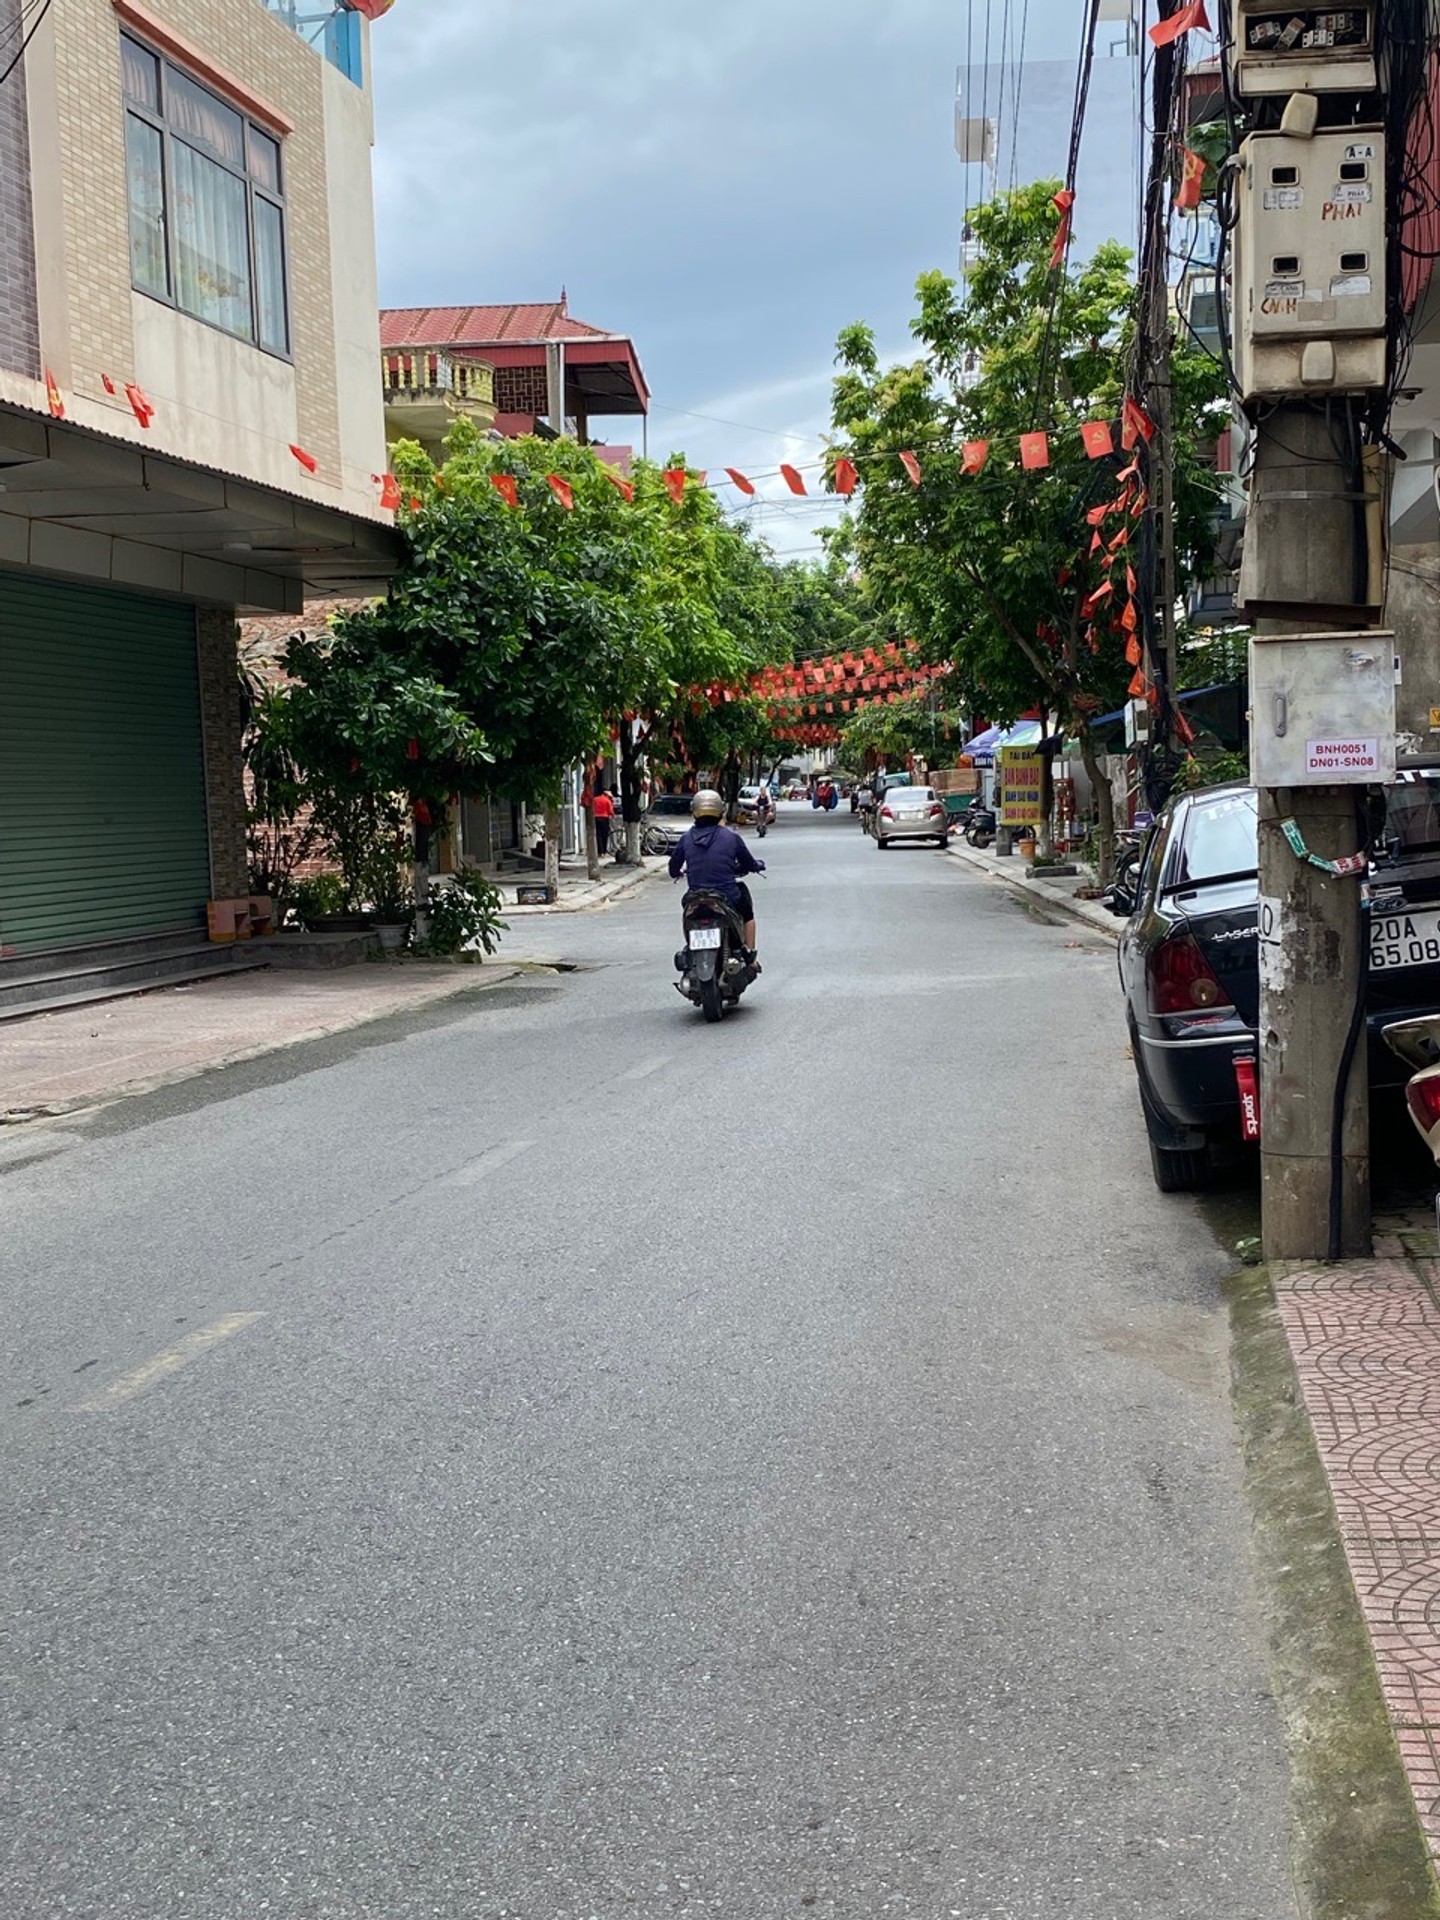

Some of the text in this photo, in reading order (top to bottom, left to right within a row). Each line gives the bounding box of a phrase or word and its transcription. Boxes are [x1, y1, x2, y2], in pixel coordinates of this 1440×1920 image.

[1315, 743, 1367, 755] BNH0051
[1309, 756, 1374, 768] DN01-SN08
[1371, 916, 1417, 943] 20A
[1242, 1092, 1258, 1135] sports
